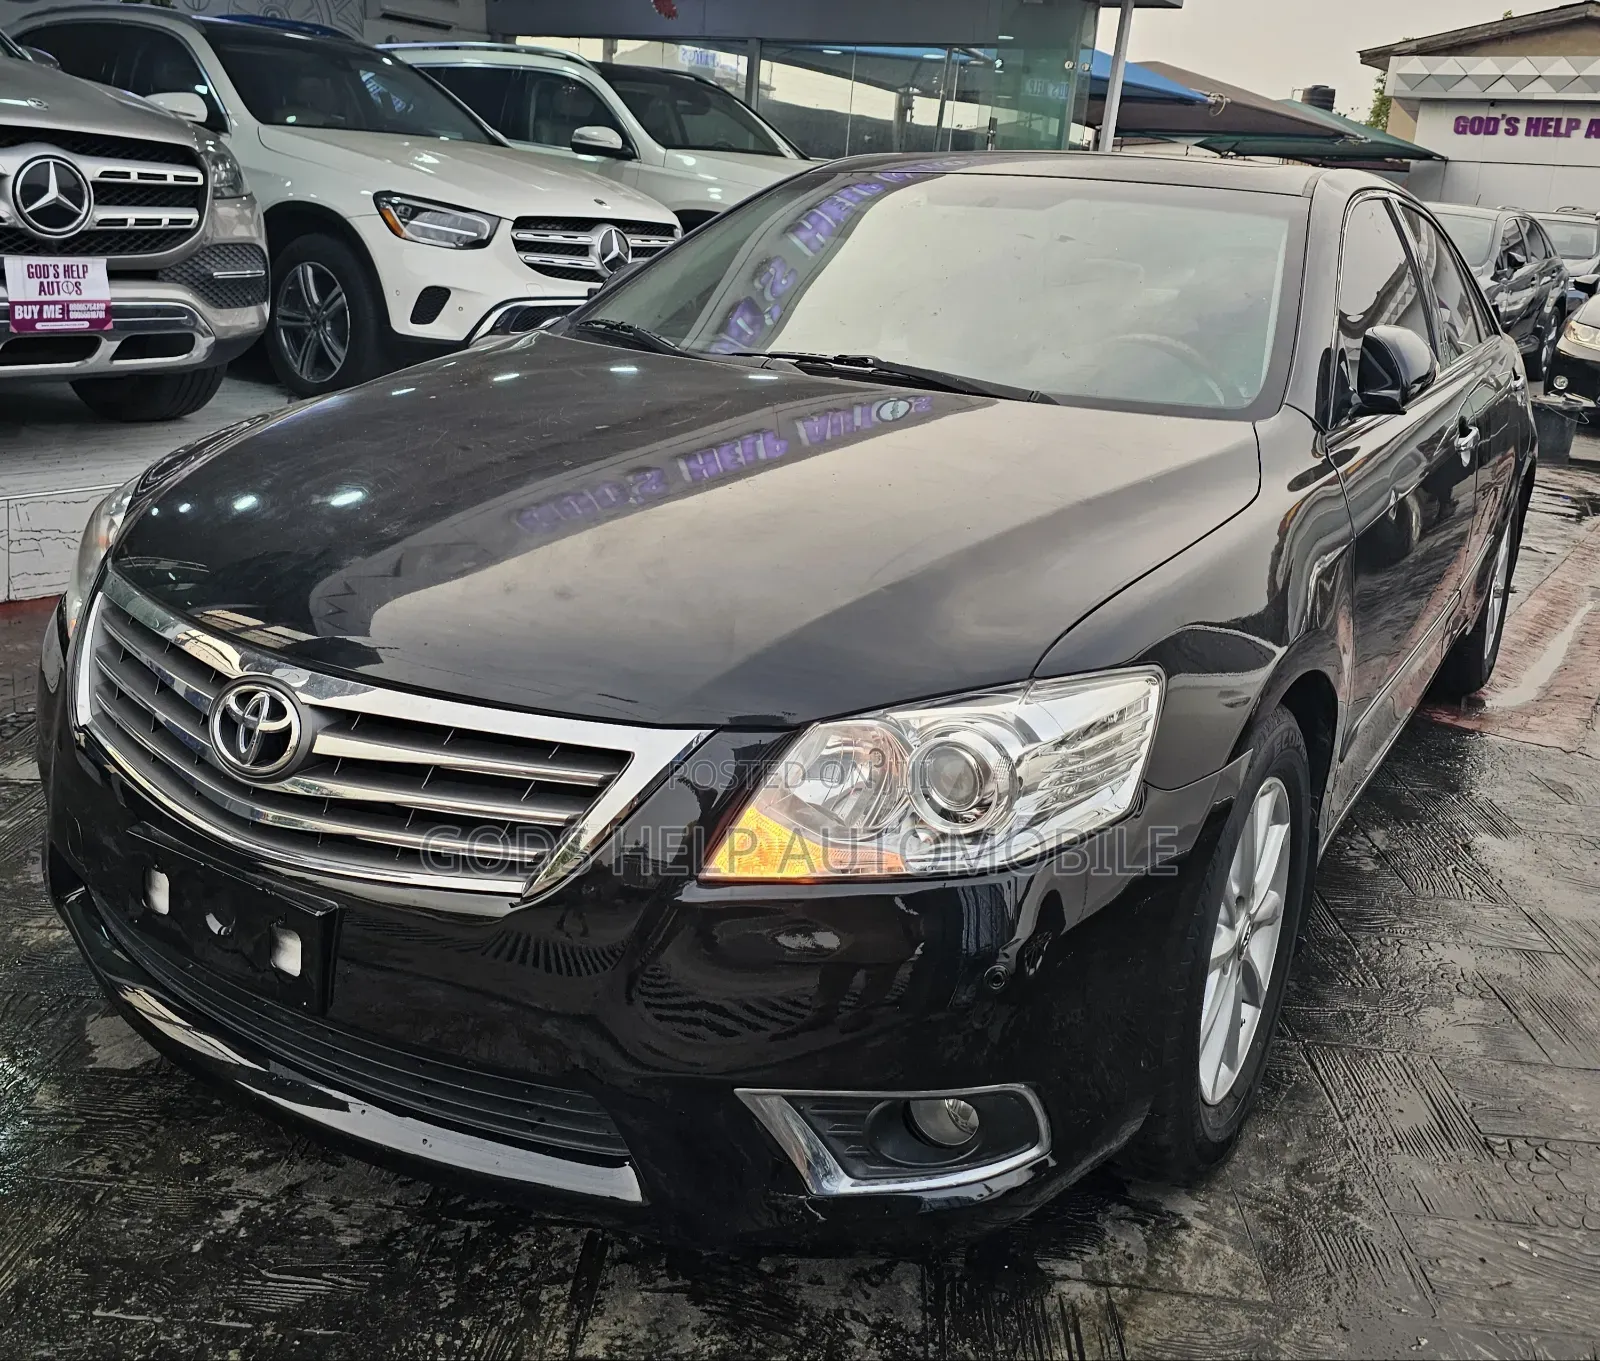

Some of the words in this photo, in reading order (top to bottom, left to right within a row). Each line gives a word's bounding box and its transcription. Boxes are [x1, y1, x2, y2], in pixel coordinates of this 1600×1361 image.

[1453, 114, 1520, 136] GOD'S
[1525, 117, 1581, 138] HELP
[27, 264, 60, 279] GOD'S
[63, 264, 88, 279] HELP
[39, 281, 82, 296] AUTOS
[15, 305, 39, 319] BUY
[43, 305, 63, 318] ME
